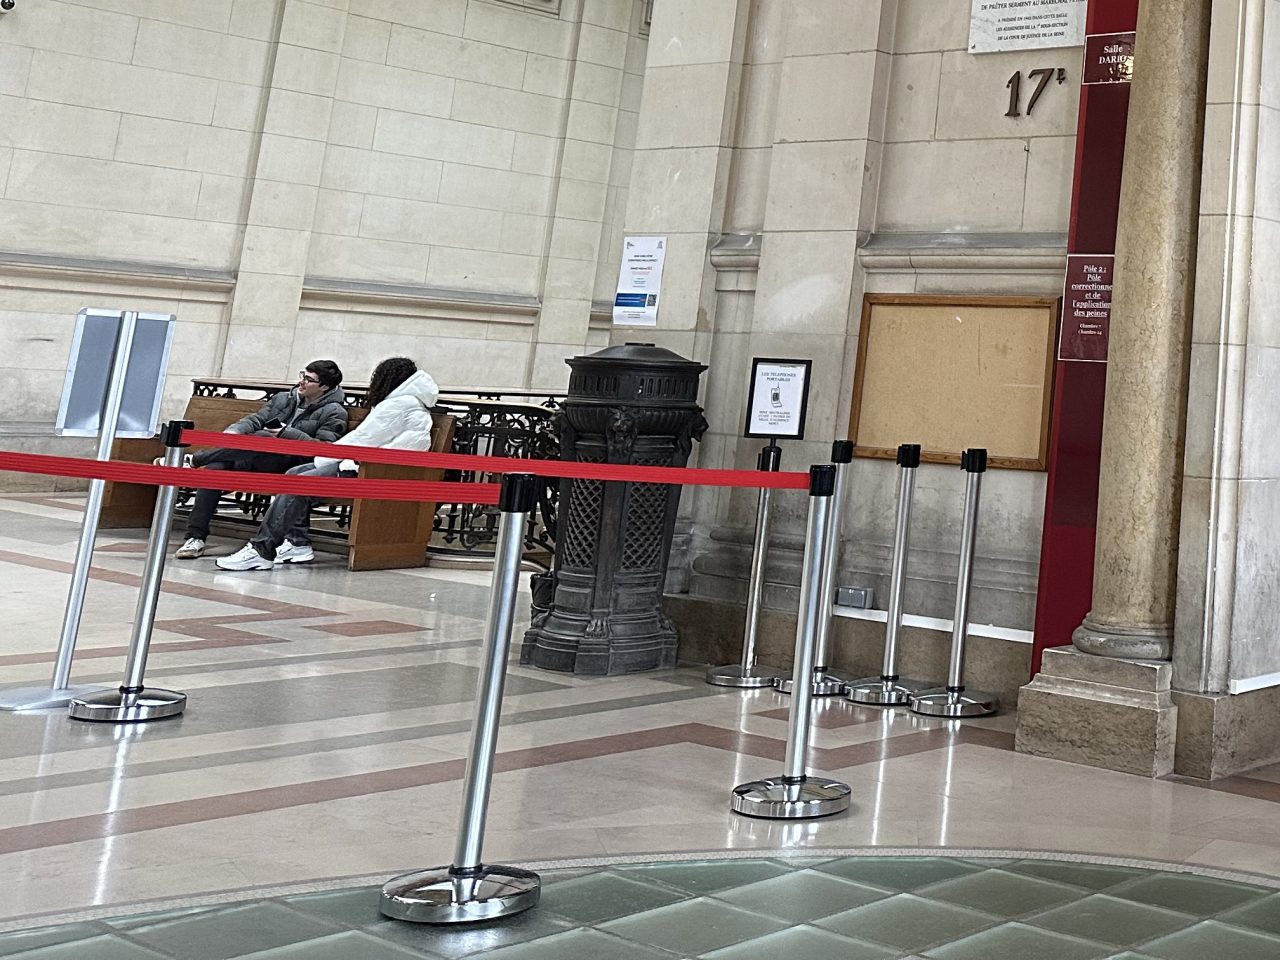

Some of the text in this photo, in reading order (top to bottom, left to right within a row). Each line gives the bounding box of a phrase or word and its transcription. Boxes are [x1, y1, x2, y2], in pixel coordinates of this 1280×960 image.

[1103, 44, 1123, 54] Salle
[1083, 264, 1098, 273] Pôle
[1086, 273, 1102, 282] Pôle
[1085, 291, 1101, 300] et de
[1073, 309, 1108, 318] des peines
